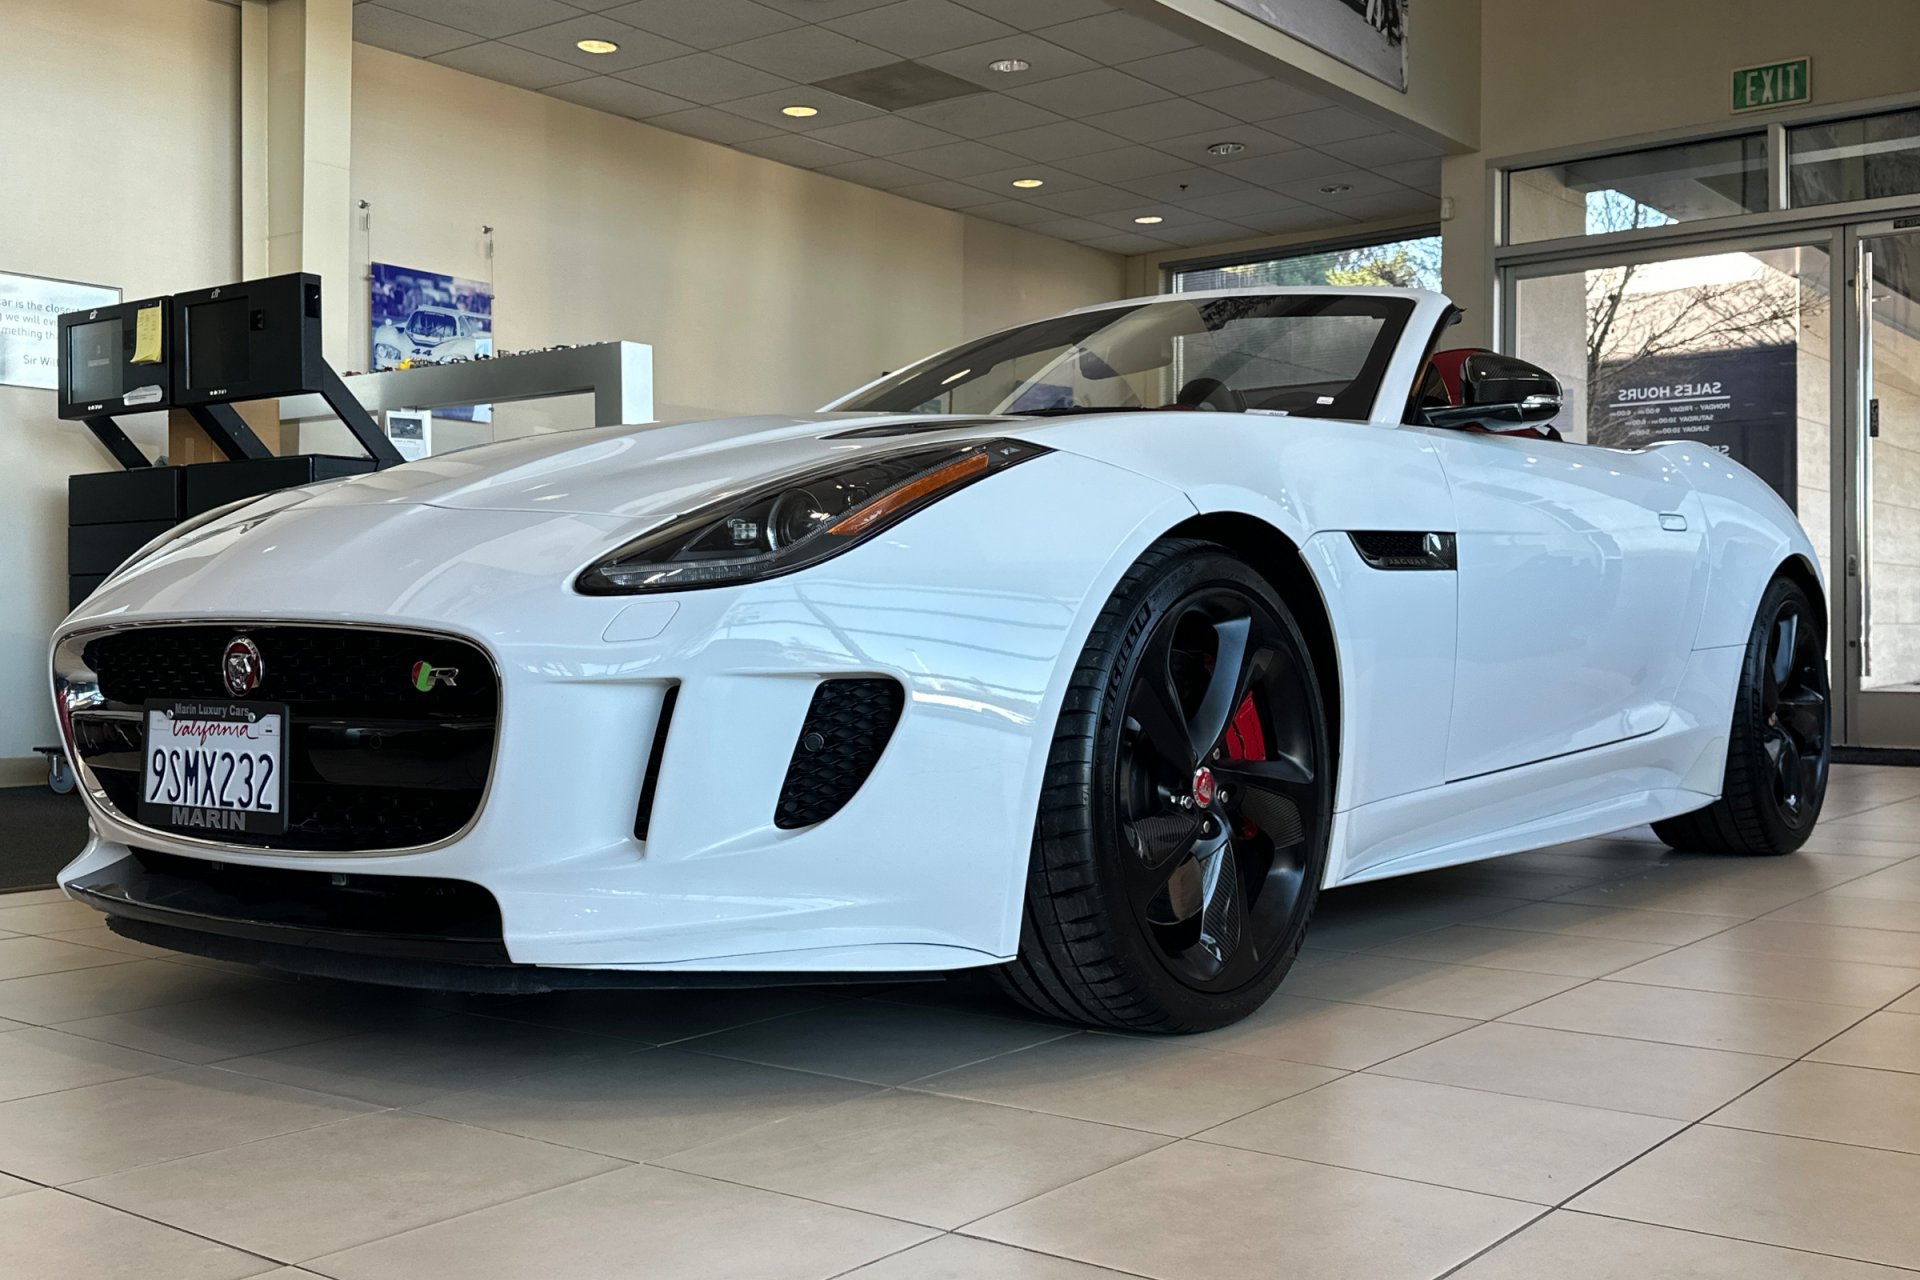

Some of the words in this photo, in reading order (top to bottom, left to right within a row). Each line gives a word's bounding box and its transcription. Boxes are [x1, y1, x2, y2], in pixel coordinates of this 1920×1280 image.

[1745, 65, 1798, 105] EXIT
[15, 298, 24, 309] is
[27, 300, 43, 311] the
[5, 313, 20, 322] we
[22, 314, 41, 325] will
[23, 354, 37, 365] Sir
[411, 348, 432, 356] 44
[1389, 557, 1428, 566] JAGUAR
[1104, 602, 1150, 724] MICHELIN
[175, 703, 197, 714] Marin
[198, 704, 228, 718] Luxury
[229, 705, 250, 717] Cars
[172, 719, 259, 746] California
[150, 748, 274, 810] 9SMX232
[171, 805, 246, 831] MARIN
